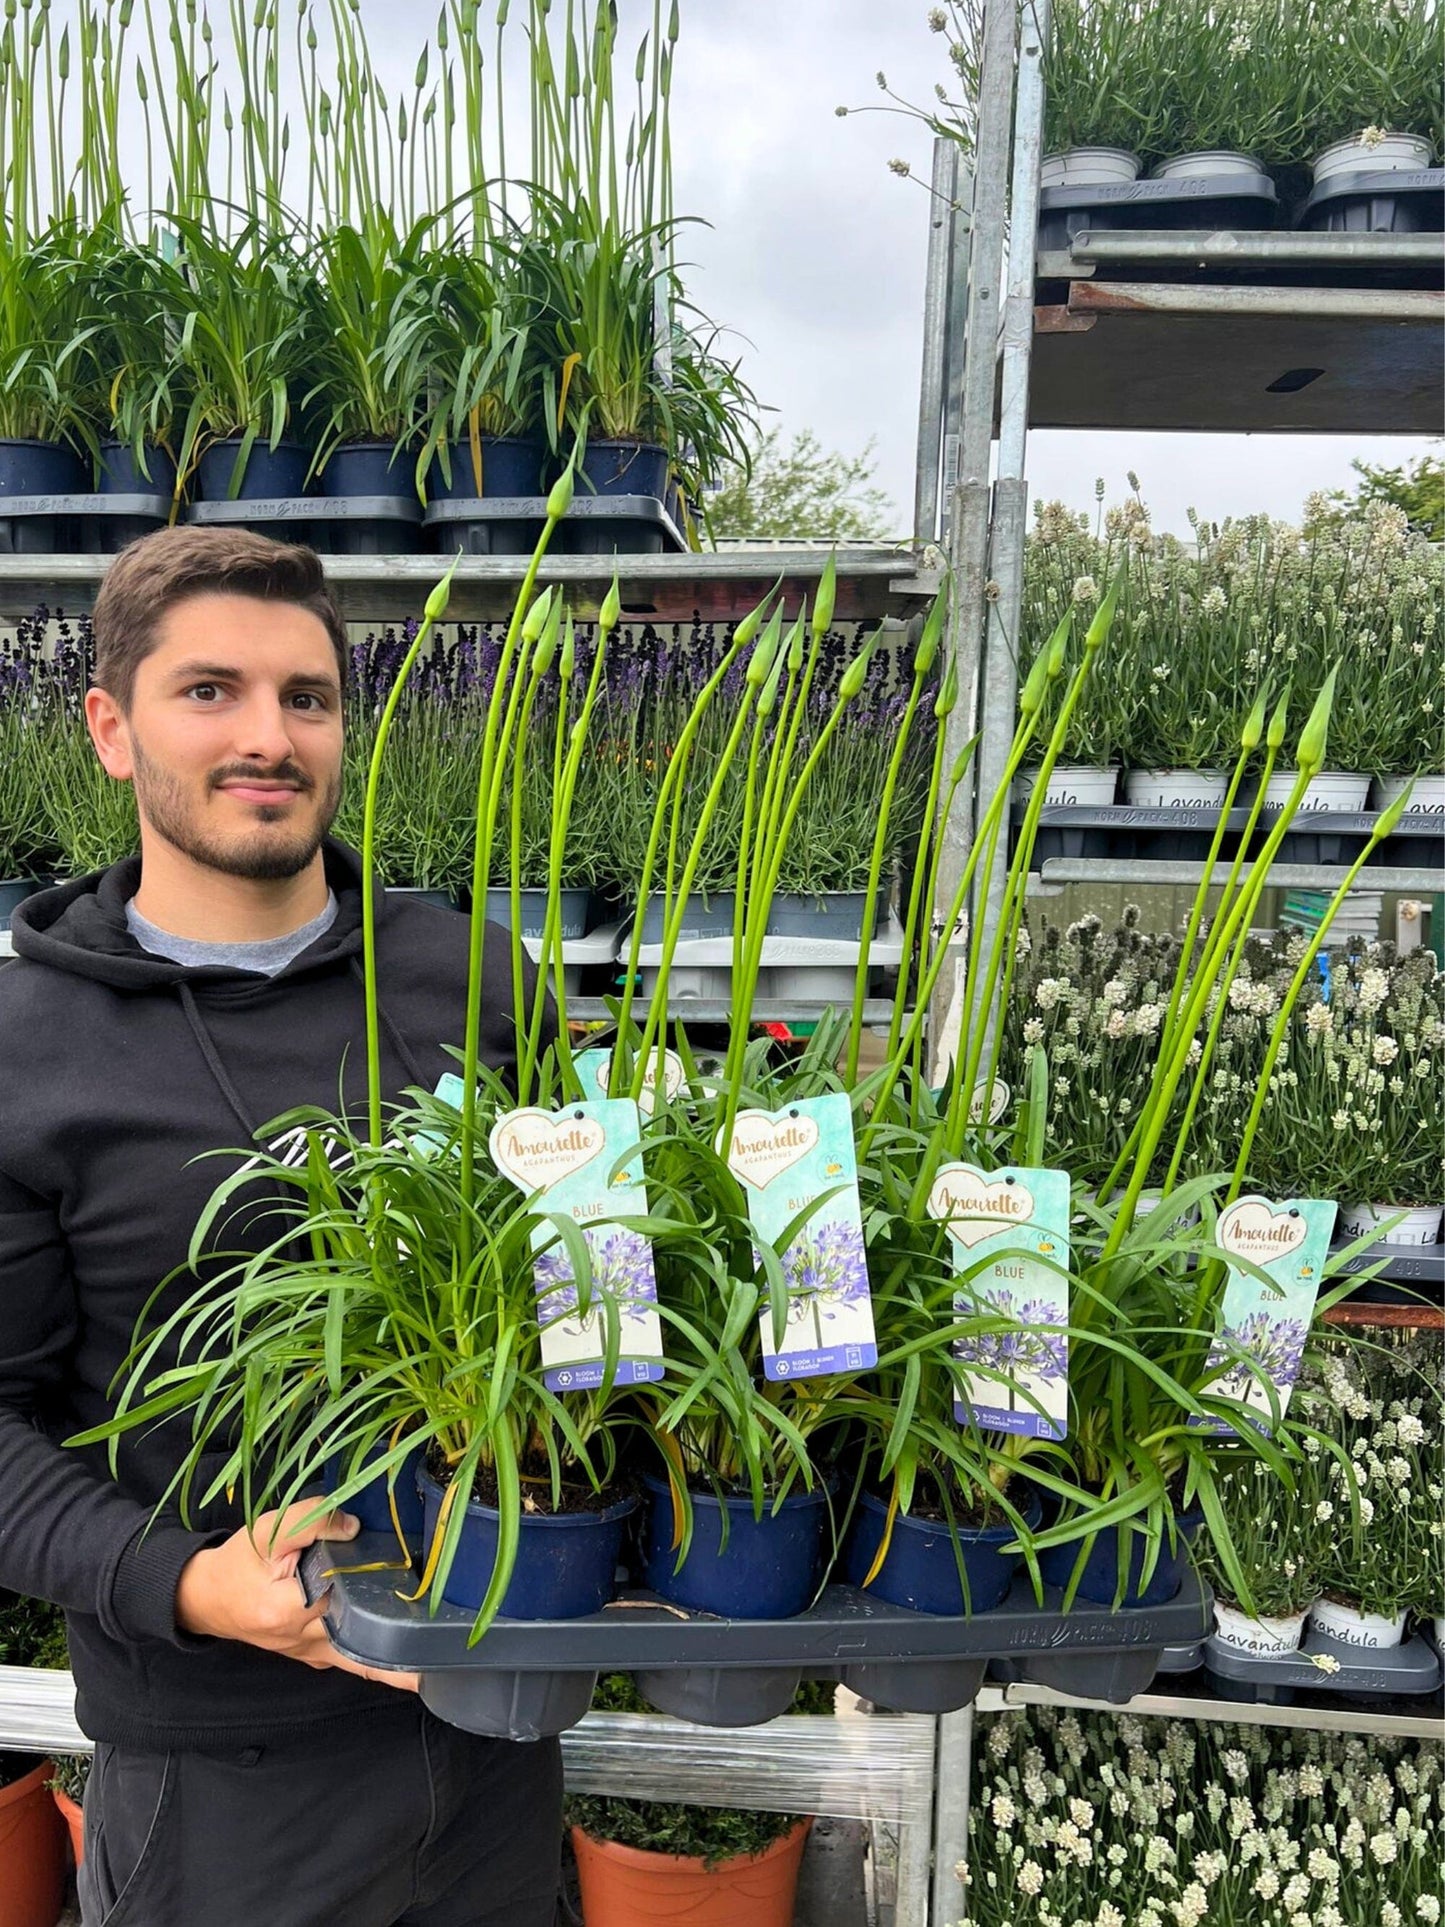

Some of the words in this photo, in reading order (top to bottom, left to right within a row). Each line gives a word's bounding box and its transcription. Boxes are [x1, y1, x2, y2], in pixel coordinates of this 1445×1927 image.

[507, 1129, 594, 1158] Amourette
[523, 1155, 576, 1167] AGAPANTHUS
[744, 1151, 792, 1165] AGAPANTHUS
[572, 1203, 605, 1218] BLUE
[1227, 1219, 1298, 1243] Amourette
[994, 1265, 1025, 1280] BLUE
